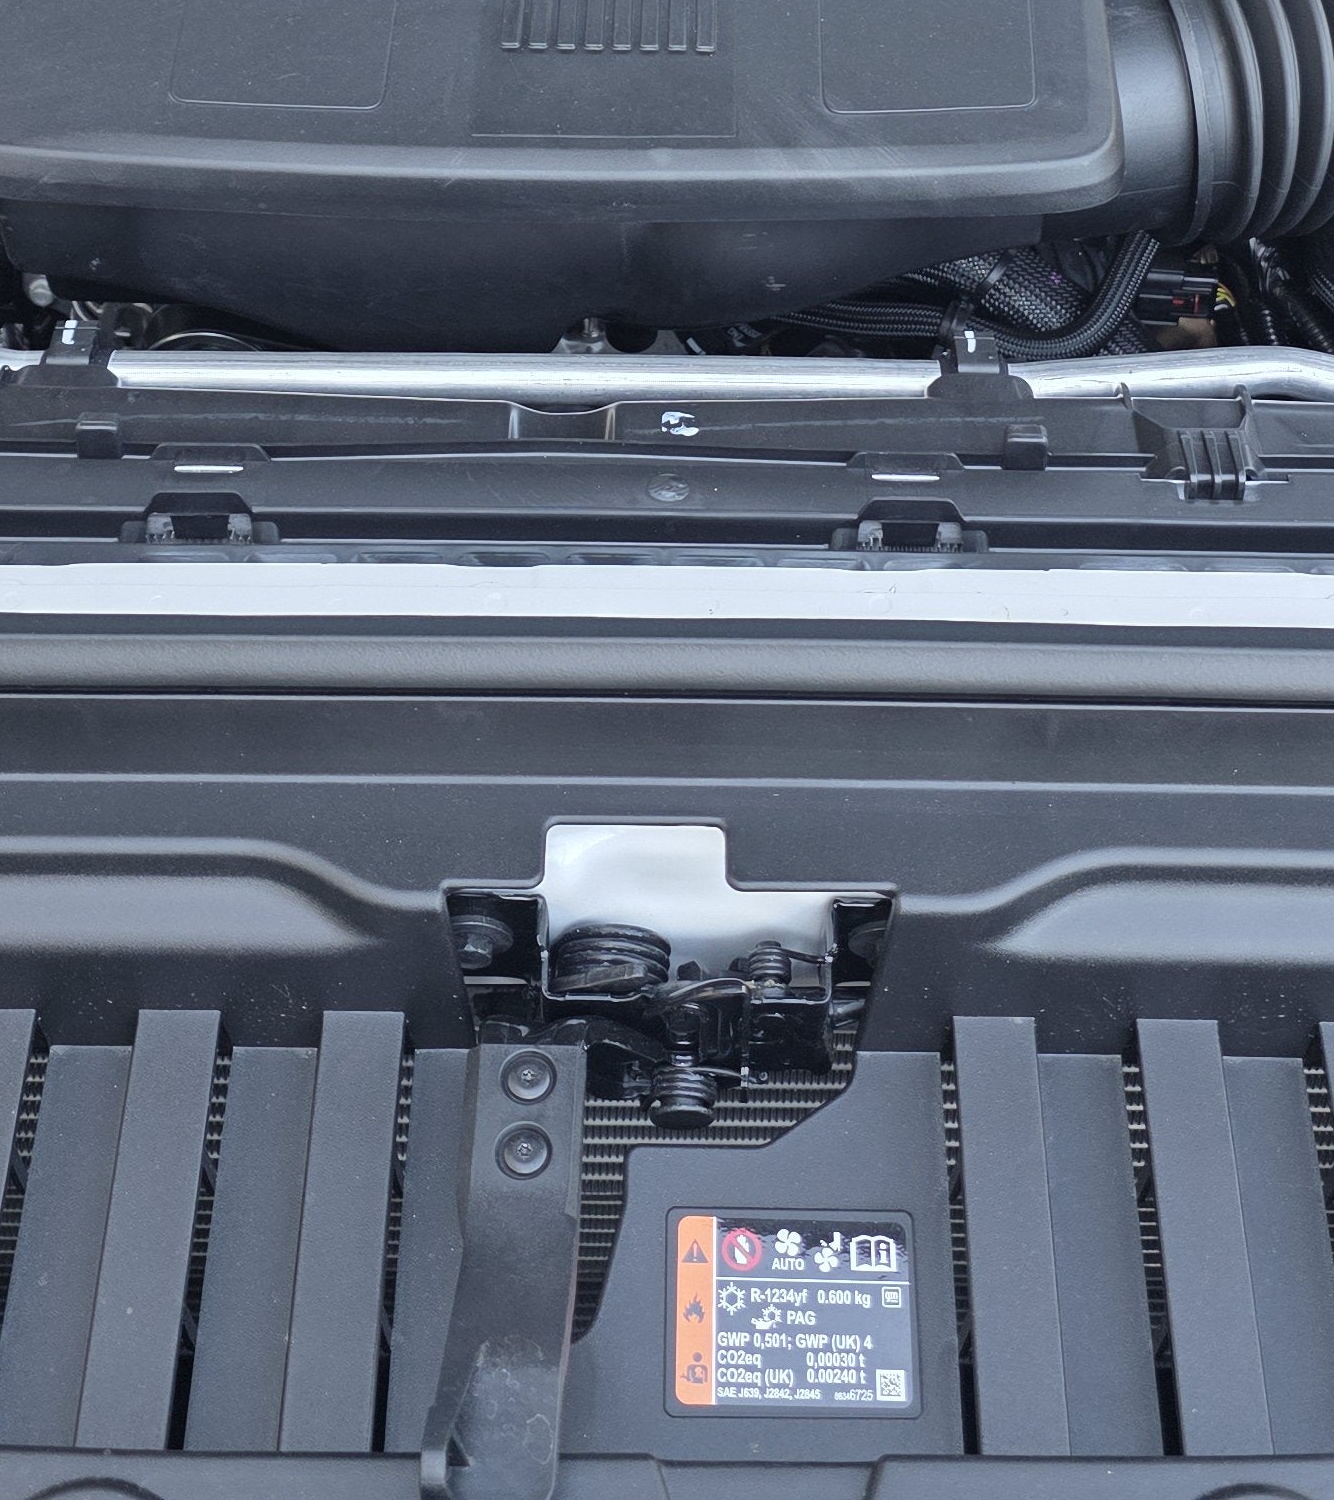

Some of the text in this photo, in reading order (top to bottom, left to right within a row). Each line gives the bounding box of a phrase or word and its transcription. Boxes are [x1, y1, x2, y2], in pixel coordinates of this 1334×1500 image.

[772, 1257, 805, 1271] AUTO
[750, 1287, 871, 1309] R-1234yf 0.600 kg
[786, 1310, 817, 1326] PAG
[717, 1331, 873, 1353] GWP 0,501; GWP (UK) 4
[717, 1349, 866, 1369] CO2eq 0,00030 t
[717, 1367, 867, 1387] CO2eq (UK) 0.00240 t
[717, 1386, 737, 1398] SAE
